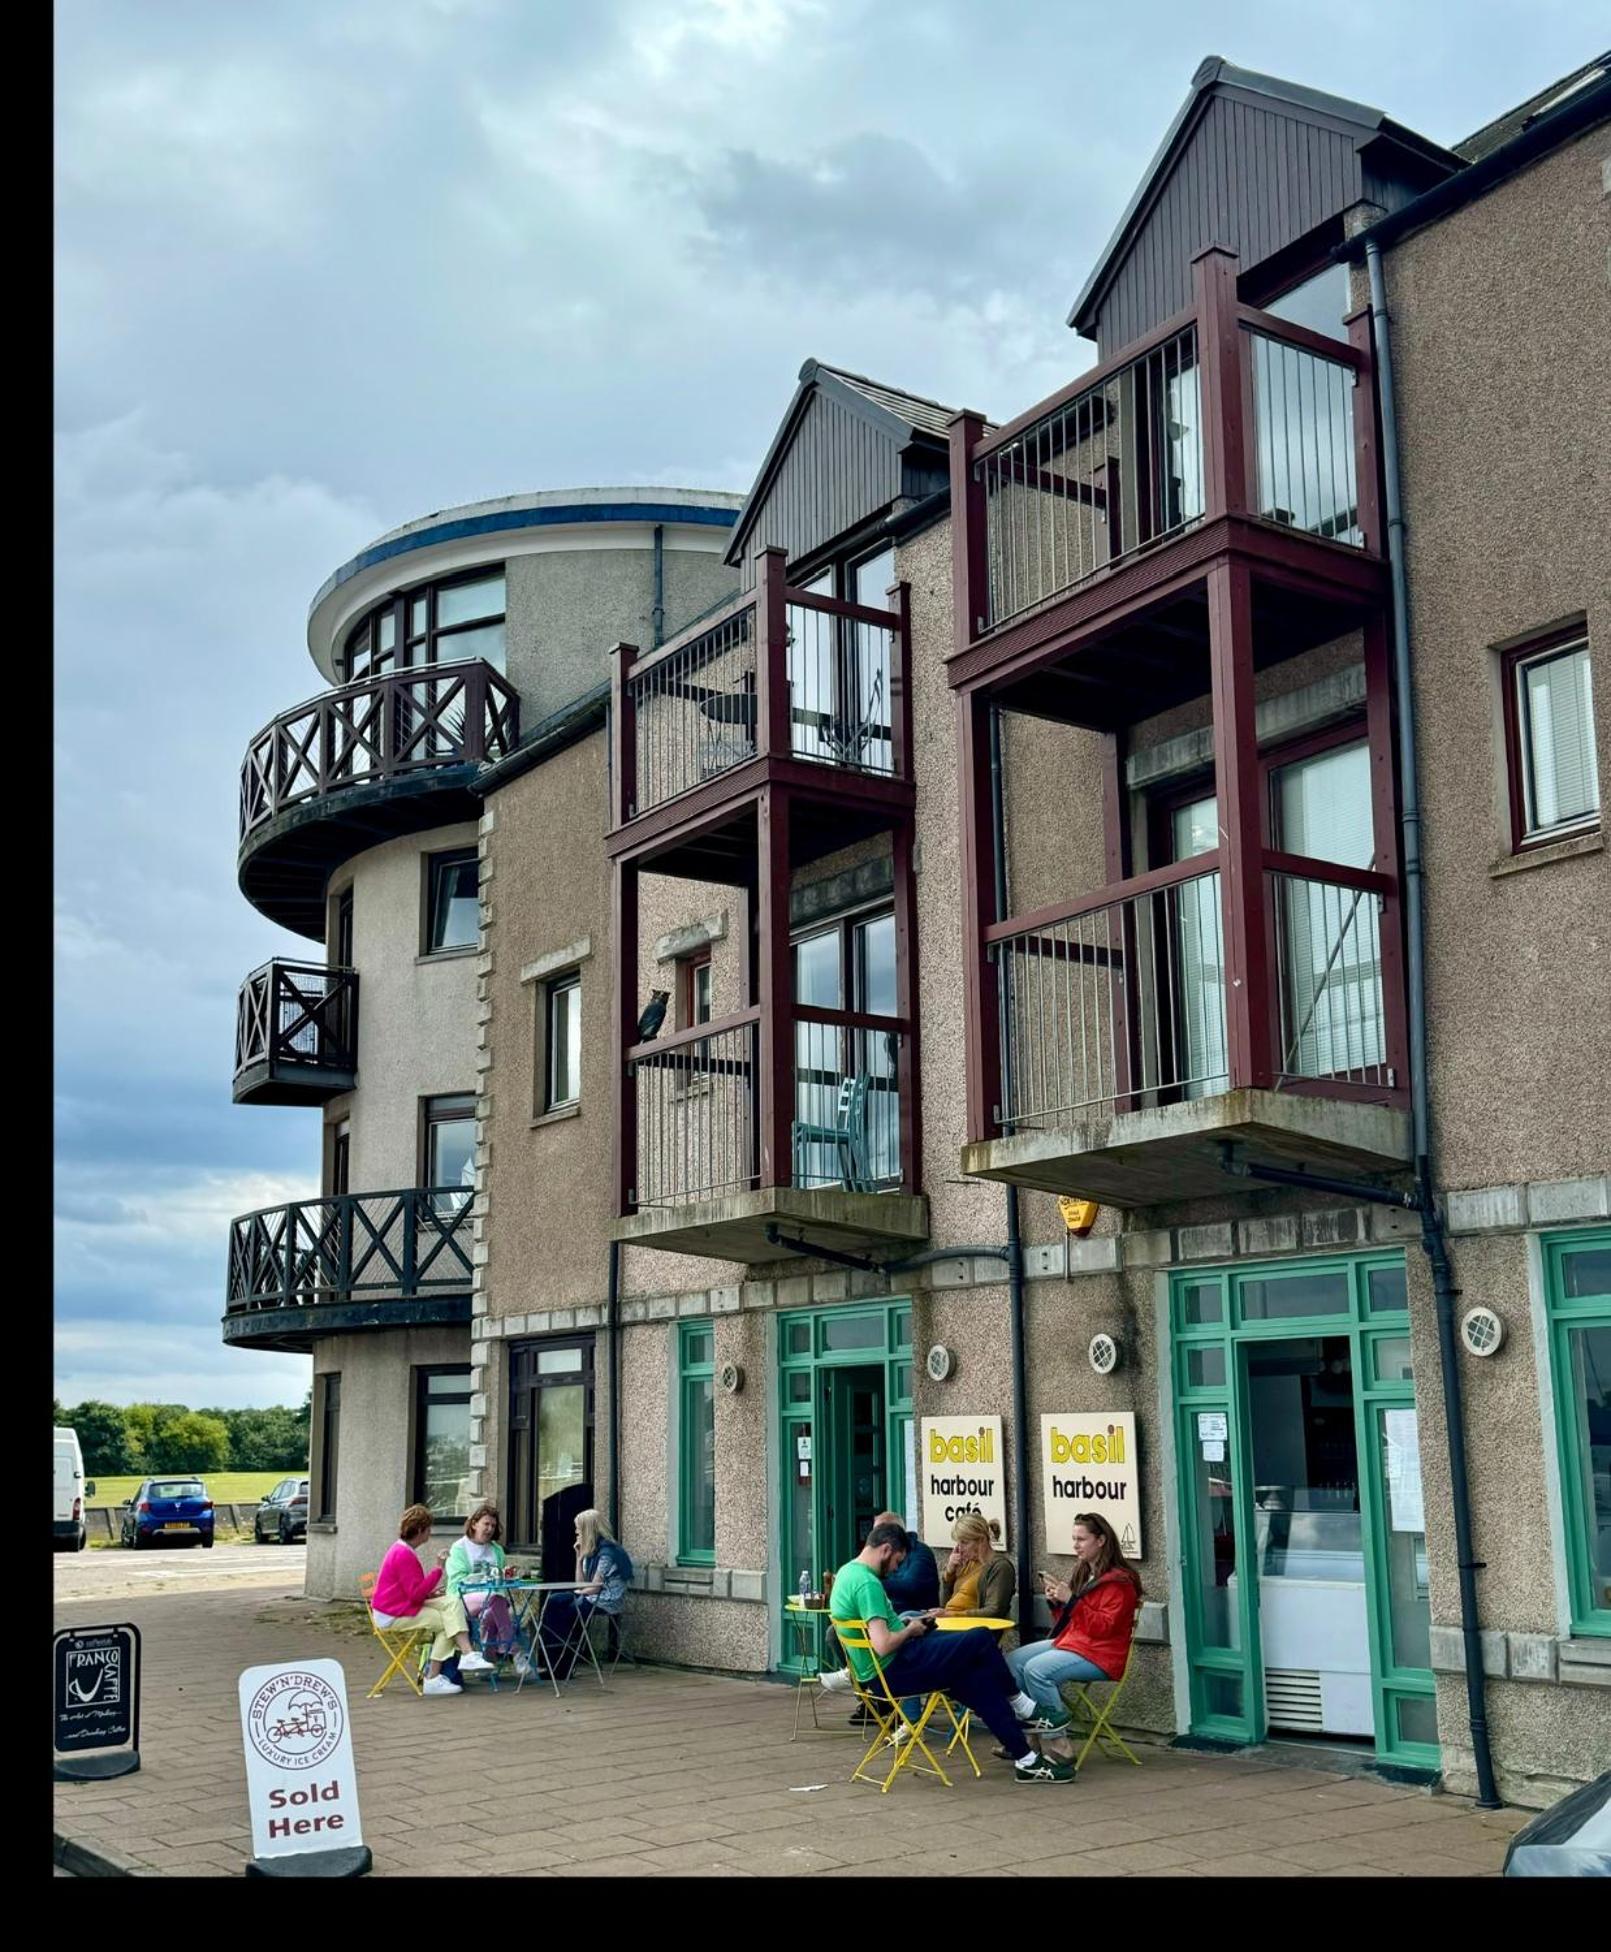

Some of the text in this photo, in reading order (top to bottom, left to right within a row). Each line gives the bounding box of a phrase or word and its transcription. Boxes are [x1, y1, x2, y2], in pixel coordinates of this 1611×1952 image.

[930, 1426, 994, 1463] basil
[1050, 1424, 1126, 1464] basil
[931, 1474, 995, 1496] harbour
[1052, 1475, 1127, 1500] harbour
[259, 1731, 337, 1766] LUXURY ICE CREAM
[269, 1780, 339, 1809] Sold
[269, 1814, 344, 1839] Here
